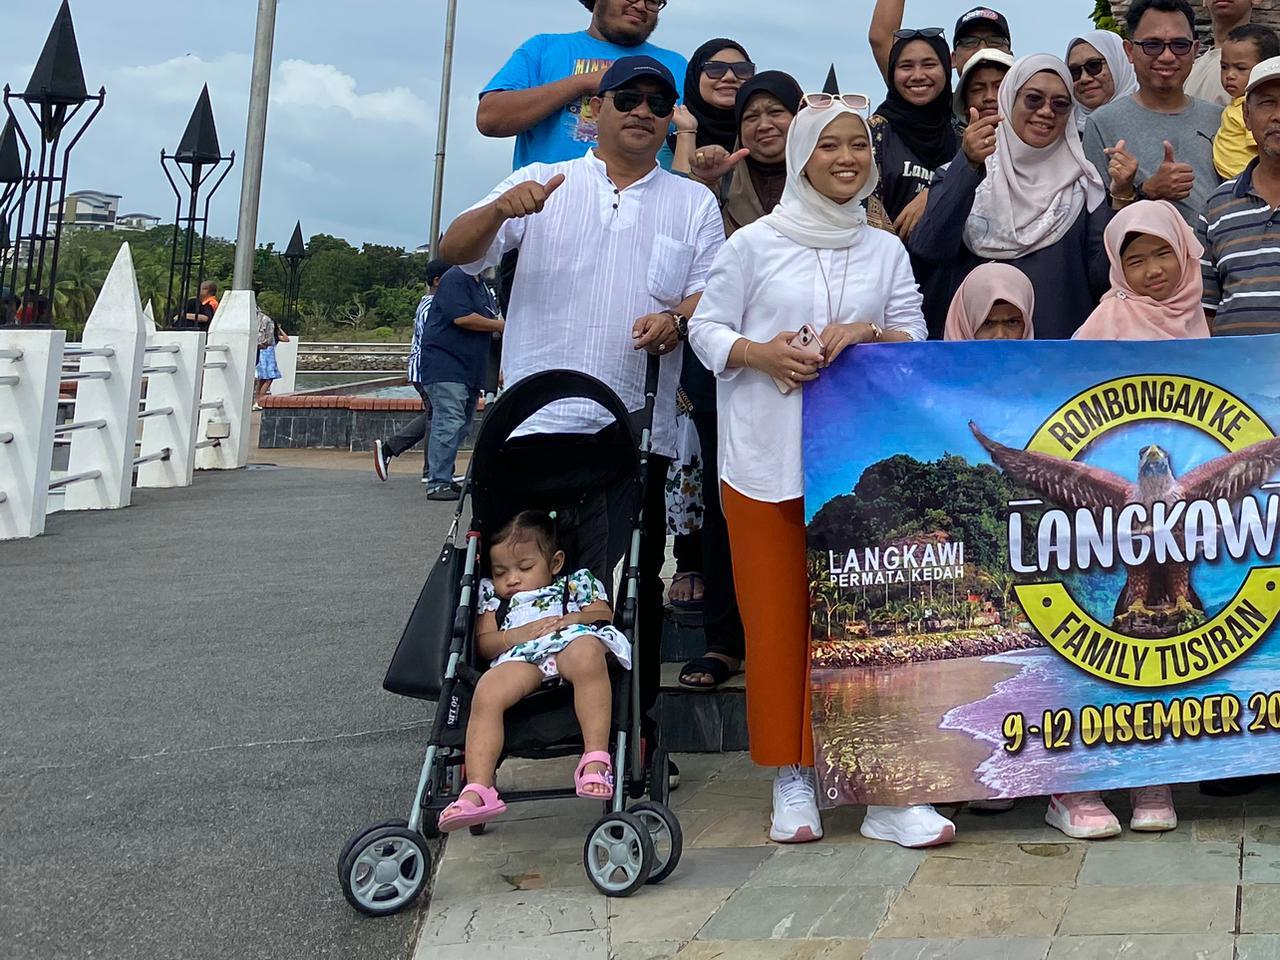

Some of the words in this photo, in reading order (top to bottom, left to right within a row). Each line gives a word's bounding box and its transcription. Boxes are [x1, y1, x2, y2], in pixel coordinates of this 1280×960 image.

[1048, 381, 1214, 452] ROMBONGAN
[1208, 398, 1250, 443] KE
[829, 541, 964, 574] LANGKAWI
[830, 570, 905, 587] PERMATA
[911, 565, 964, 582] KEDAH
[1050, 611, 1150, 681] FAMILY
[1155, 598, 1268, 680] TUSIRAN
[1078, 692, 1241, 745] DISEMBER
